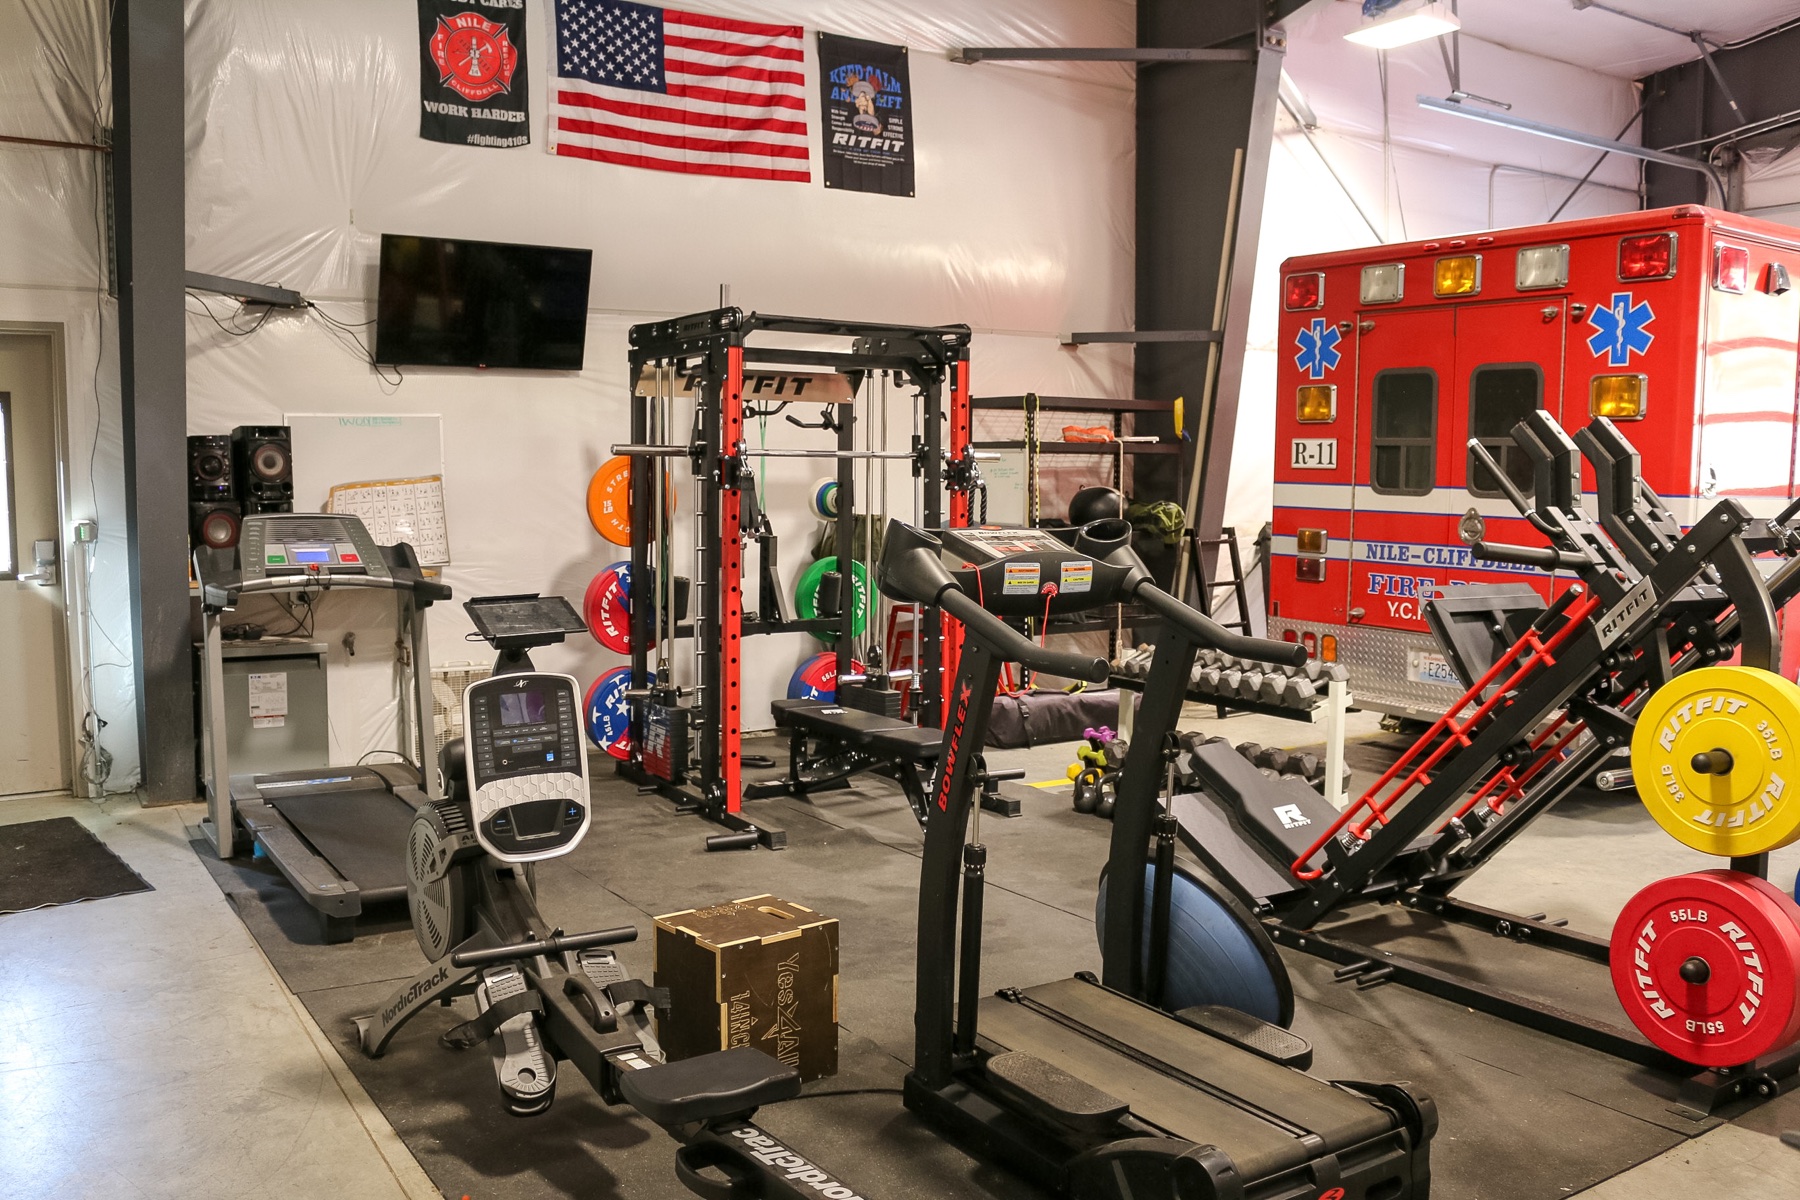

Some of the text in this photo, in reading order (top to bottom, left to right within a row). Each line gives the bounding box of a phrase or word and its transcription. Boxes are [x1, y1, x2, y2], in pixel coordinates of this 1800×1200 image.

[456, 17, 491, 32] NILE
[437, 34, 445, 66] FIRE
[502, 40, 510, 77] RESCUE
[451, 79, 499, 96] CLIFFDELL
[876, 94, 902, 109] LIFT
[424, 100, 525, 122] WORK HARDER
[832, 132, 905, 152] RITFIT
[1293, 442, 1335, 465] R-11
[603, 500, 612, 508] 15
[1368, 572, 1435, 599] FIRE
[601, 581, 619, 637] RITFIT
[1601, 588, 1648, 639] RITFIT
[821, 670, 837, 682] 55L
[1428, 661, 1460, 681] E254
[1659, 695, 1748, 752] RITFIT
[1756, 719, 1783, 760] 35LB
[938, 679, 973, 812] BOWFLEX
[1661, 764, 1685, 802] 35LB
[1693, 772, 1786, 828] RITFIT
[1669, 908, 1709, 923] 55LB
[1635, 919, 1676, 1020] RITFIT
[1718, 921, 1764, 1026] RITFIT
[381, 966, 449, 1027] NordicTrack
[731, 990, 750, 1050] 14INC
[1685, 1019, 1725, 1035] 55LB
[731, 1127, 869, 1200] ordicTrac
